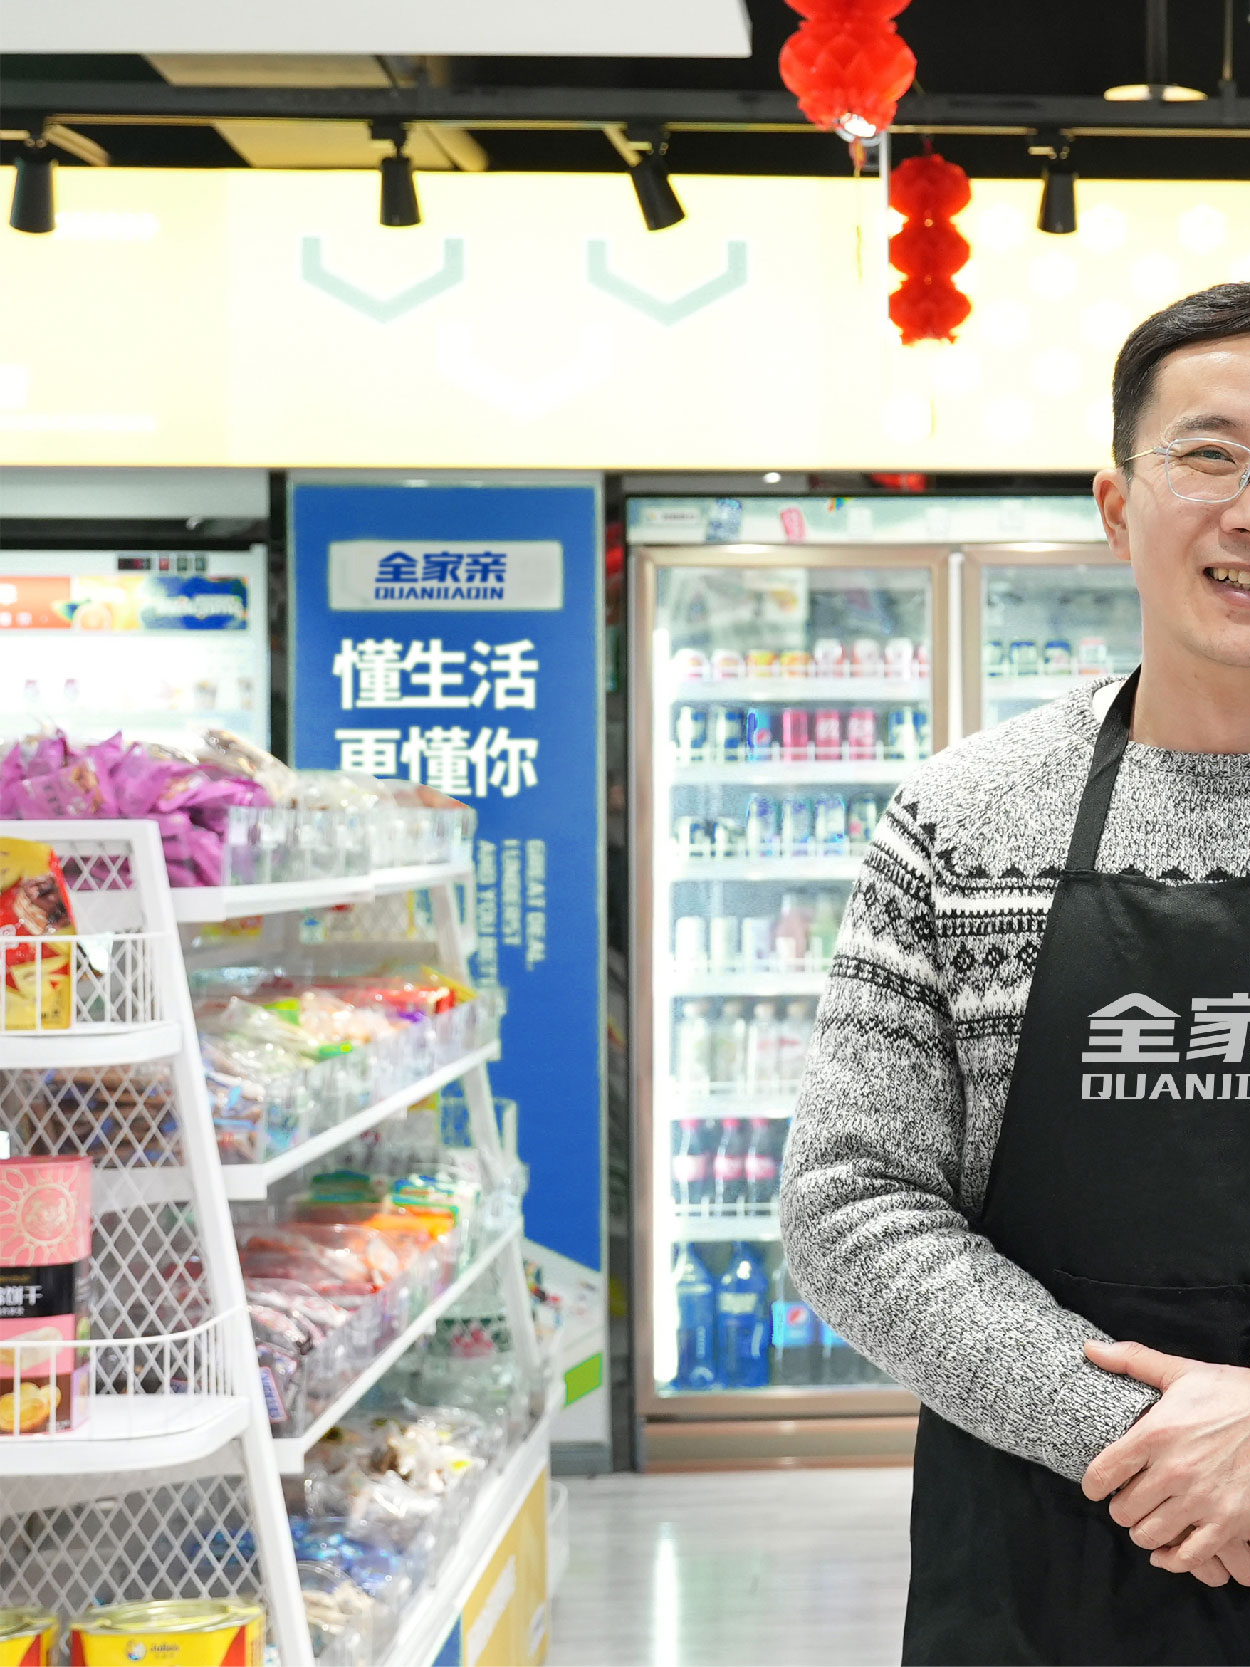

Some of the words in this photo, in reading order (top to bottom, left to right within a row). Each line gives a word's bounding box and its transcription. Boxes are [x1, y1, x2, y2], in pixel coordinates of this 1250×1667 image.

[375, 551, 507, 583] 全家亲
[375, 587, 504, 600] QUANJIAQIN
[333, 638, 539, 710] 懂生活
[334, 726, 539, 798] 更懂你
